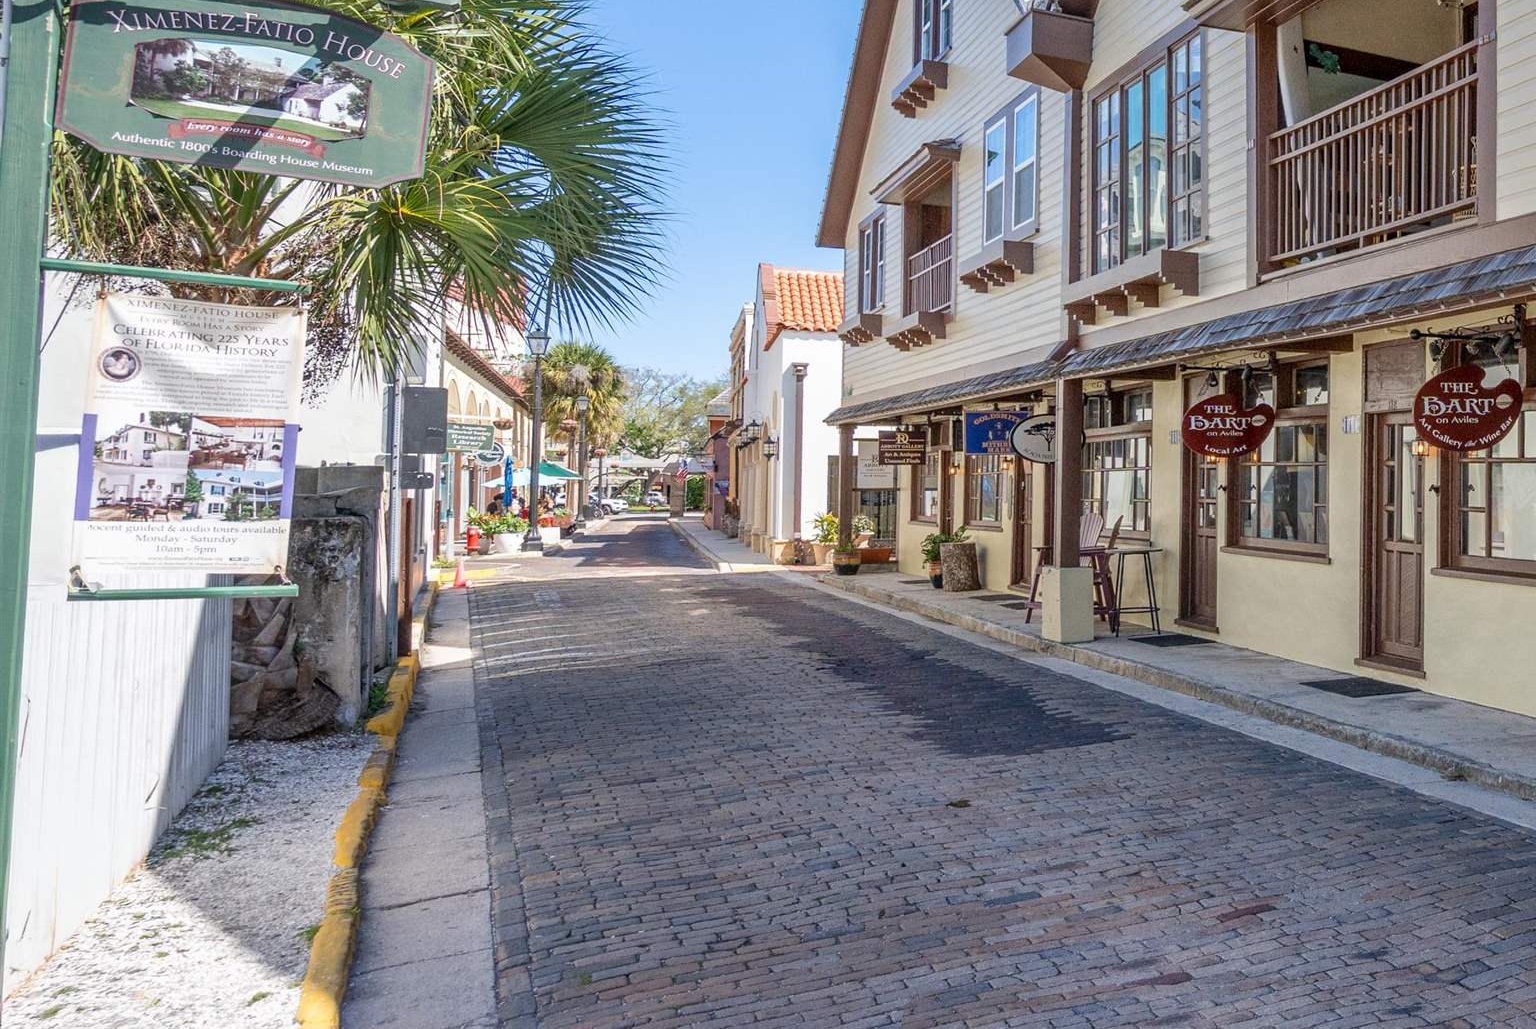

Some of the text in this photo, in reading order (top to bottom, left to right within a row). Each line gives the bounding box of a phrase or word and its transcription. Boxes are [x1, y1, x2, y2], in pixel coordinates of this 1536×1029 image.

[106, 9, 407, 79] XIMENEZ-FATIO HOUSE
[187, 122, 216, 132] Every
[219, 125, 251, 135] room
[254, 128, 275, 139] has
[286, 135, 311, 147] story
[111, 131, 374, 176] Authentic 1800's Boarding House Museum
[128, 299, 279, 319] XIMENEZ-FATIO HOUSE
[113, 323, 289, 347] CELEBRATING 225 YEARS
[122, 338, 278, 357] OF FLORIDA HISTORY
[1440, 382, 1478, 395] THE
[1204, 404, 1236, 415] THE
[1421, 396, 1495, 416] BART
[1188, 415, 1251, 430] BART
[1452, 415, 1479, 424] Aviles
[1220, 429, 1244, 437] Aviles
[1419, 417, 1431, 431] Art
[1432, 430, 1463, 449] Gallery
[1479, 430, 1501, 446] Wine
[1500, 416, 1513, 431] Bar
[1204, 444, 1248, 455] Local Art
[125, 524, 164, 533] guided
[213, 526, 239, 534] tours
[241, 526, 287, 534] available
[135, 534, 180, 544] Monday
[190, 535, 238, 545] Saturday
[156, 545, 184, 553] 10am
[194, 545, 217, 554] 5pm
